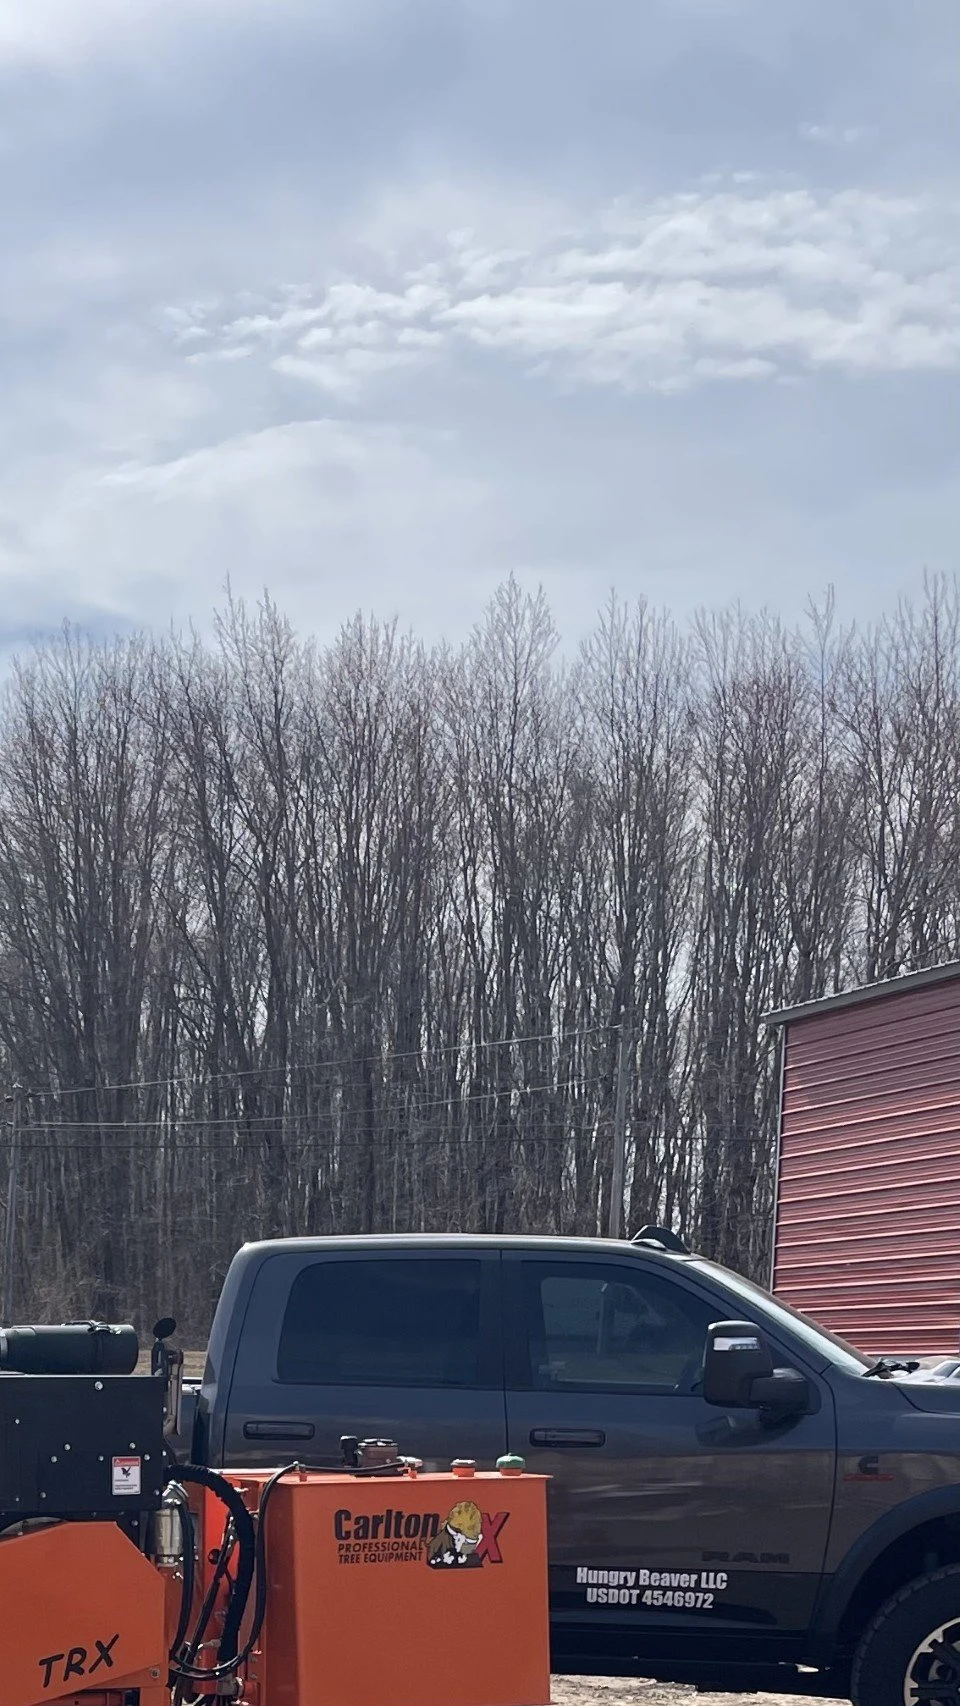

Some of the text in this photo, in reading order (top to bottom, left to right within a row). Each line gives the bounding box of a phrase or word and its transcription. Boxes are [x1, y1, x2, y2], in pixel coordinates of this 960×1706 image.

[334, 1509, 440, 1540] Carlton
[338, 1540, 424, 1554] PROFESSIONAL
[338, 1551, 423, 1565] TREE EQUIPMENT
[701, 1551, 790, 1564] RAM
[576, 1567, 728, 1589] Hungry Beaver LLC
[586, 1587, 714, 1609] USDOT 4546972
[38, 1633, 120, 1688] TRX
